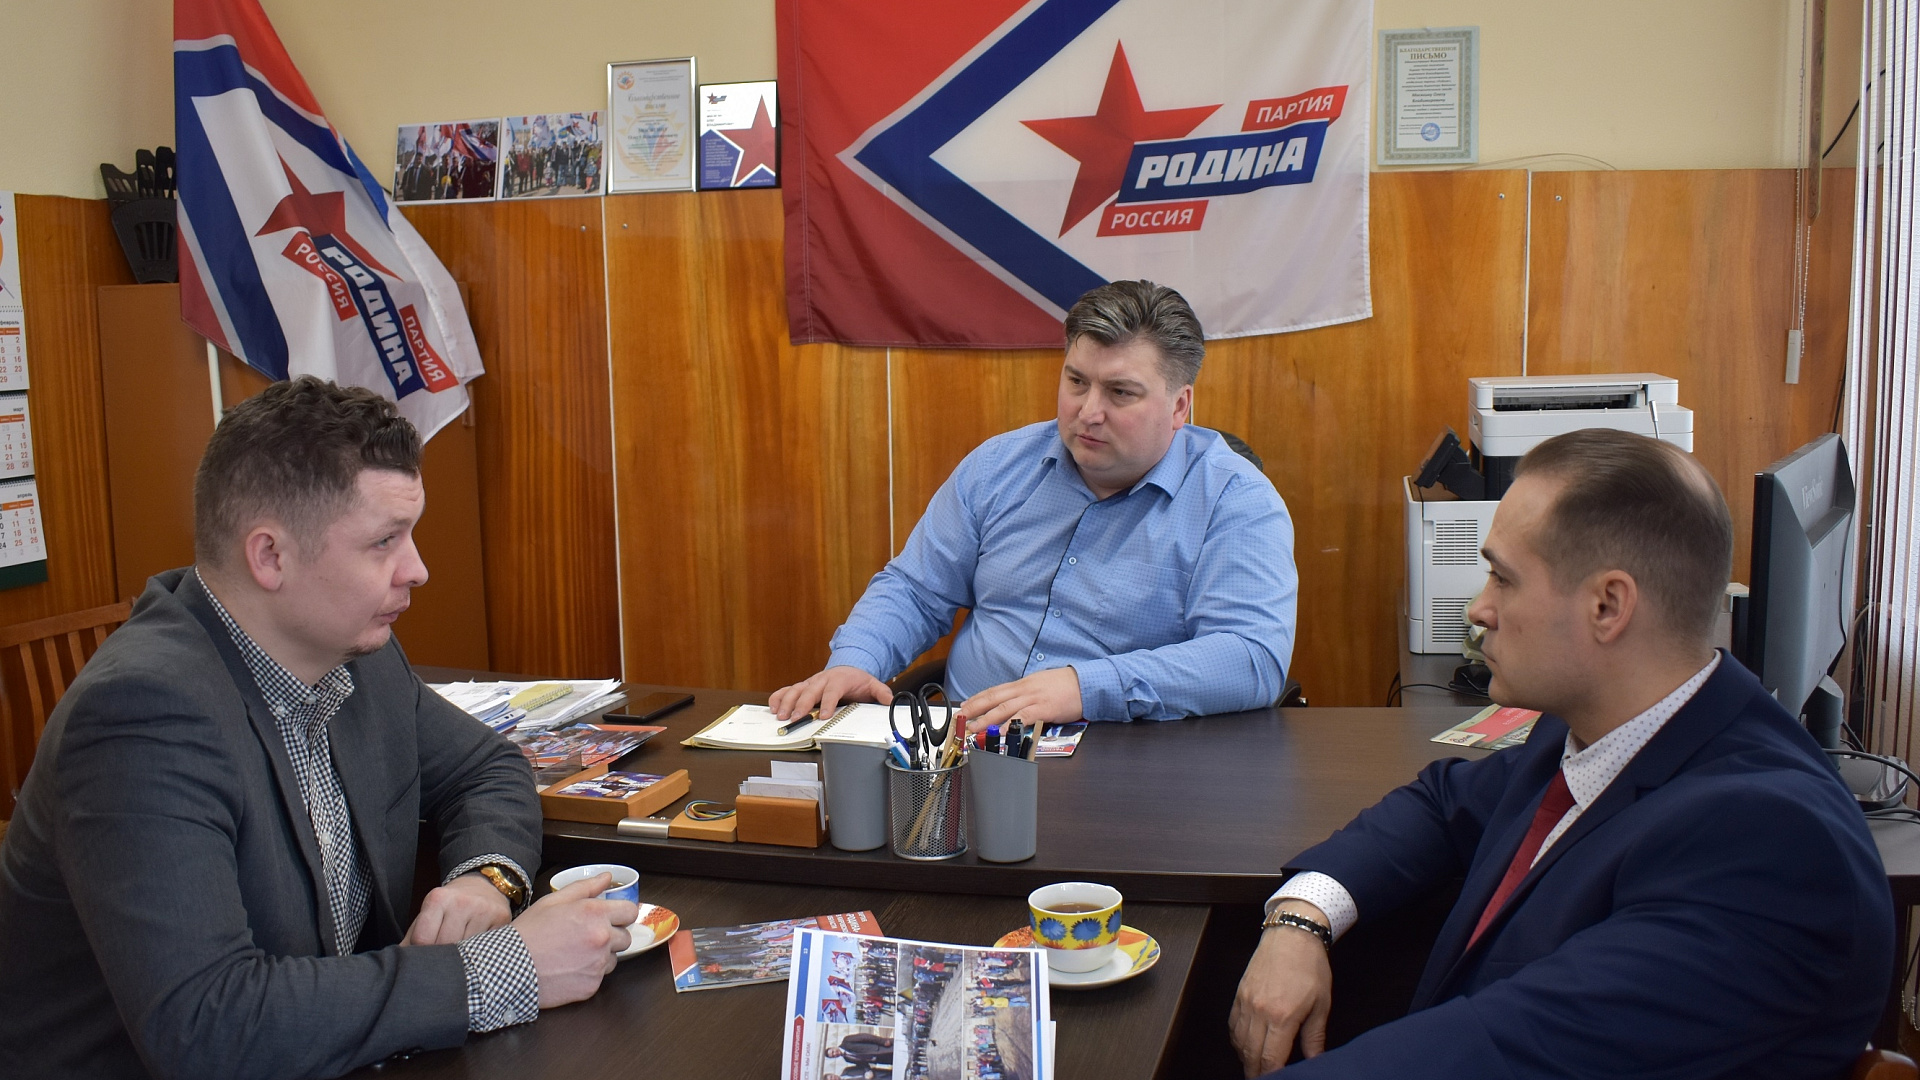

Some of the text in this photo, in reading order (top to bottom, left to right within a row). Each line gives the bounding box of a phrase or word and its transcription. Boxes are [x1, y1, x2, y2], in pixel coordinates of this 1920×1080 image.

[1410, 52, 1447, 60] ПИСЬМО
[1256, 94, 1334, 123] ПАРТИЯ
[1135, 137, 1308, 189] РОДИНА
[1111, 208, 1194, 229] РОССИЯ
[295, 243, 349, 309] РОССИЯ
[321, 246, 413, 386] РОДИНА
[405, 316, 446, 382] ПАРТИЯ
